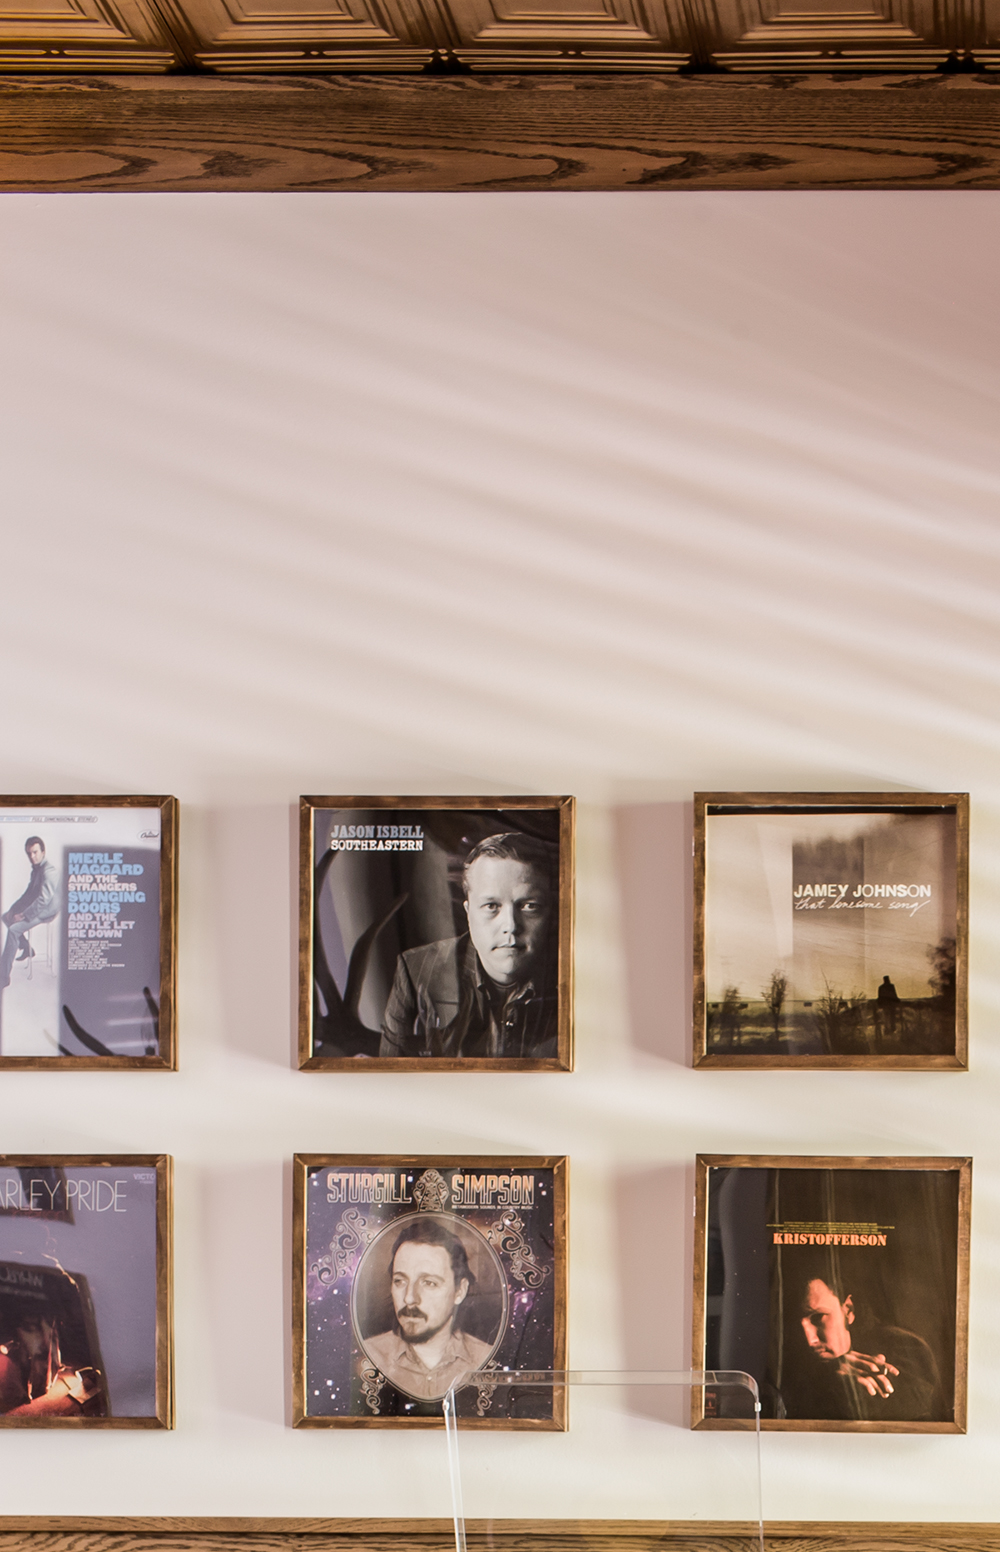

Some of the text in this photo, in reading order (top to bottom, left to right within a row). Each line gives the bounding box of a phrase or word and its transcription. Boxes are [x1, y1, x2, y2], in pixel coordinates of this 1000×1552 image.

[330, 825, 424, 838] JASON ISBELL
[330, 839, 423, 851] SOUTHEASTERN
[68, 852, 123, 864] MERLE
[68, 864, 144, 875] HAGGARD
[68, 874, 118, 883] AND THE
[68, 883, 138, 892] STRANGERS
[793, 884, 931, 898] JAMEY JOHNSON
[68, 891, 146, 903] SWINGING
[68, 902, 121, 913] DOORS
[794, 895, 931, 918] that lonesome song
[68, 913, 117, 921] AND THE
[68, 921, 135, 929] BOTTLE LET
[68, 929, 123, 938] ME DOWN
[327, 1173, 535, 1205] STURGILL SIMPSON
[0, 1179, 127, 1212] RLEY PRIDE
[773, 1232, 887, 1246] KRISTOFFERSON
